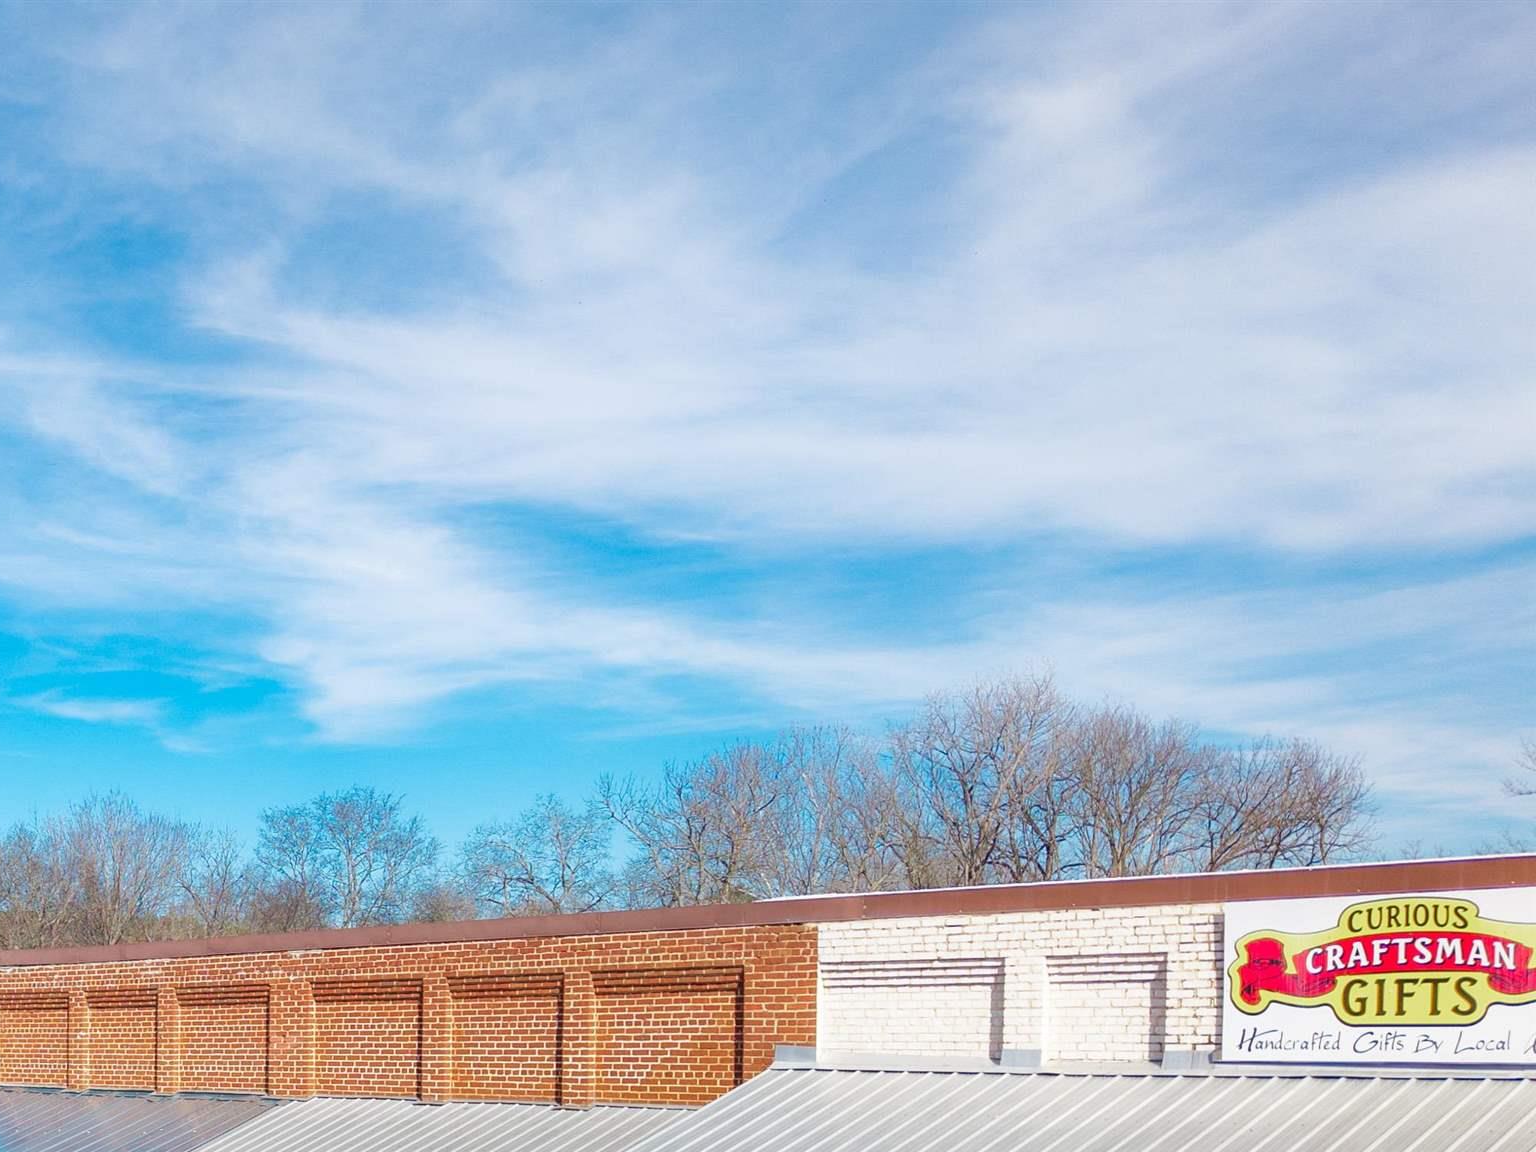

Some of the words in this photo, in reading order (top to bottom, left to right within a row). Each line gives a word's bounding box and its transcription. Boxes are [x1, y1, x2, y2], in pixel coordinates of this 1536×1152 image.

[1347, 903, 1469, 933] CURIOUS
[1305, 936, 1518, 975] CRAFTSMAN
[1342, 976, 1479, 1018] GIFTS
[1236, 1026, 1341, 1052] Handcrafted
[1353, 1030, 1405, 1054] Gifts
[1454, 1030, 1511, 1054] Local
